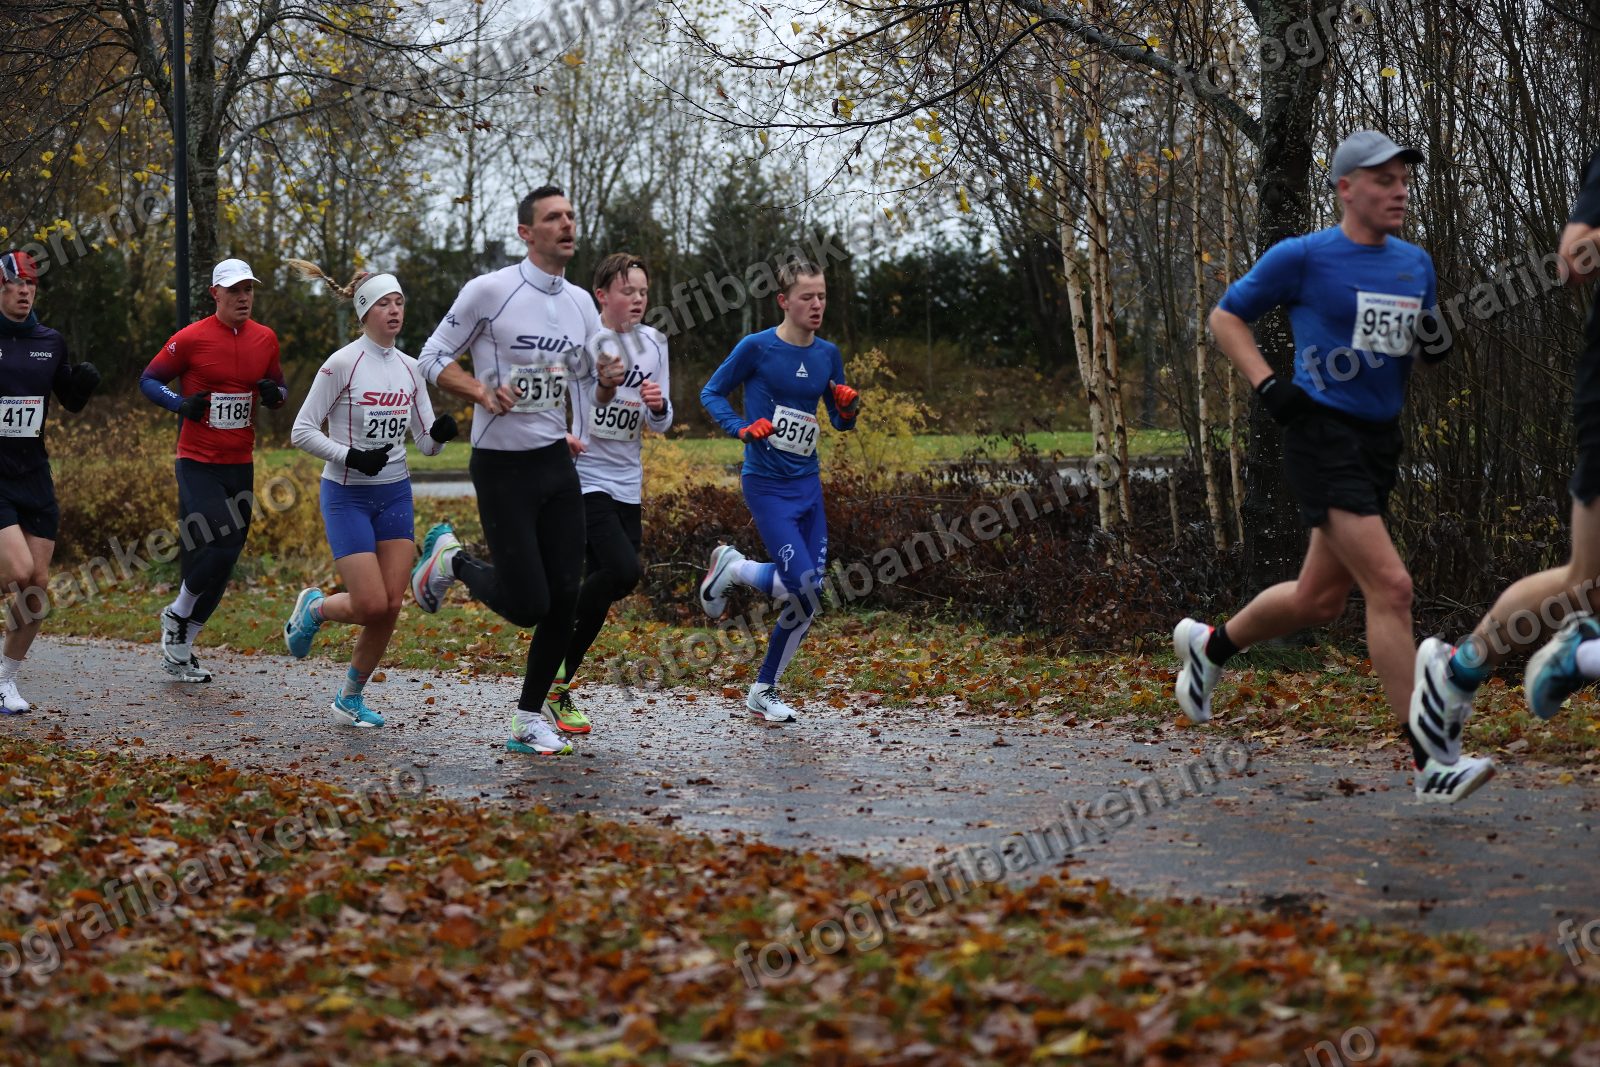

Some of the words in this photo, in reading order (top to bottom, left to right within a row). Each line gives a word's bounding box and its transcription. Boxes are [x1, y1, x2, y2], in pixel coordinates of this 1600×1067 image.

[517, 376, 563, 401] 9515
[3, 407, 36, 427] 417
[216, 402, 250, 420] 1185
[594, 407, 640, 431] 9508
[366, 417, 407, 439] 2195
[776, 418, 815, 446] 9514
